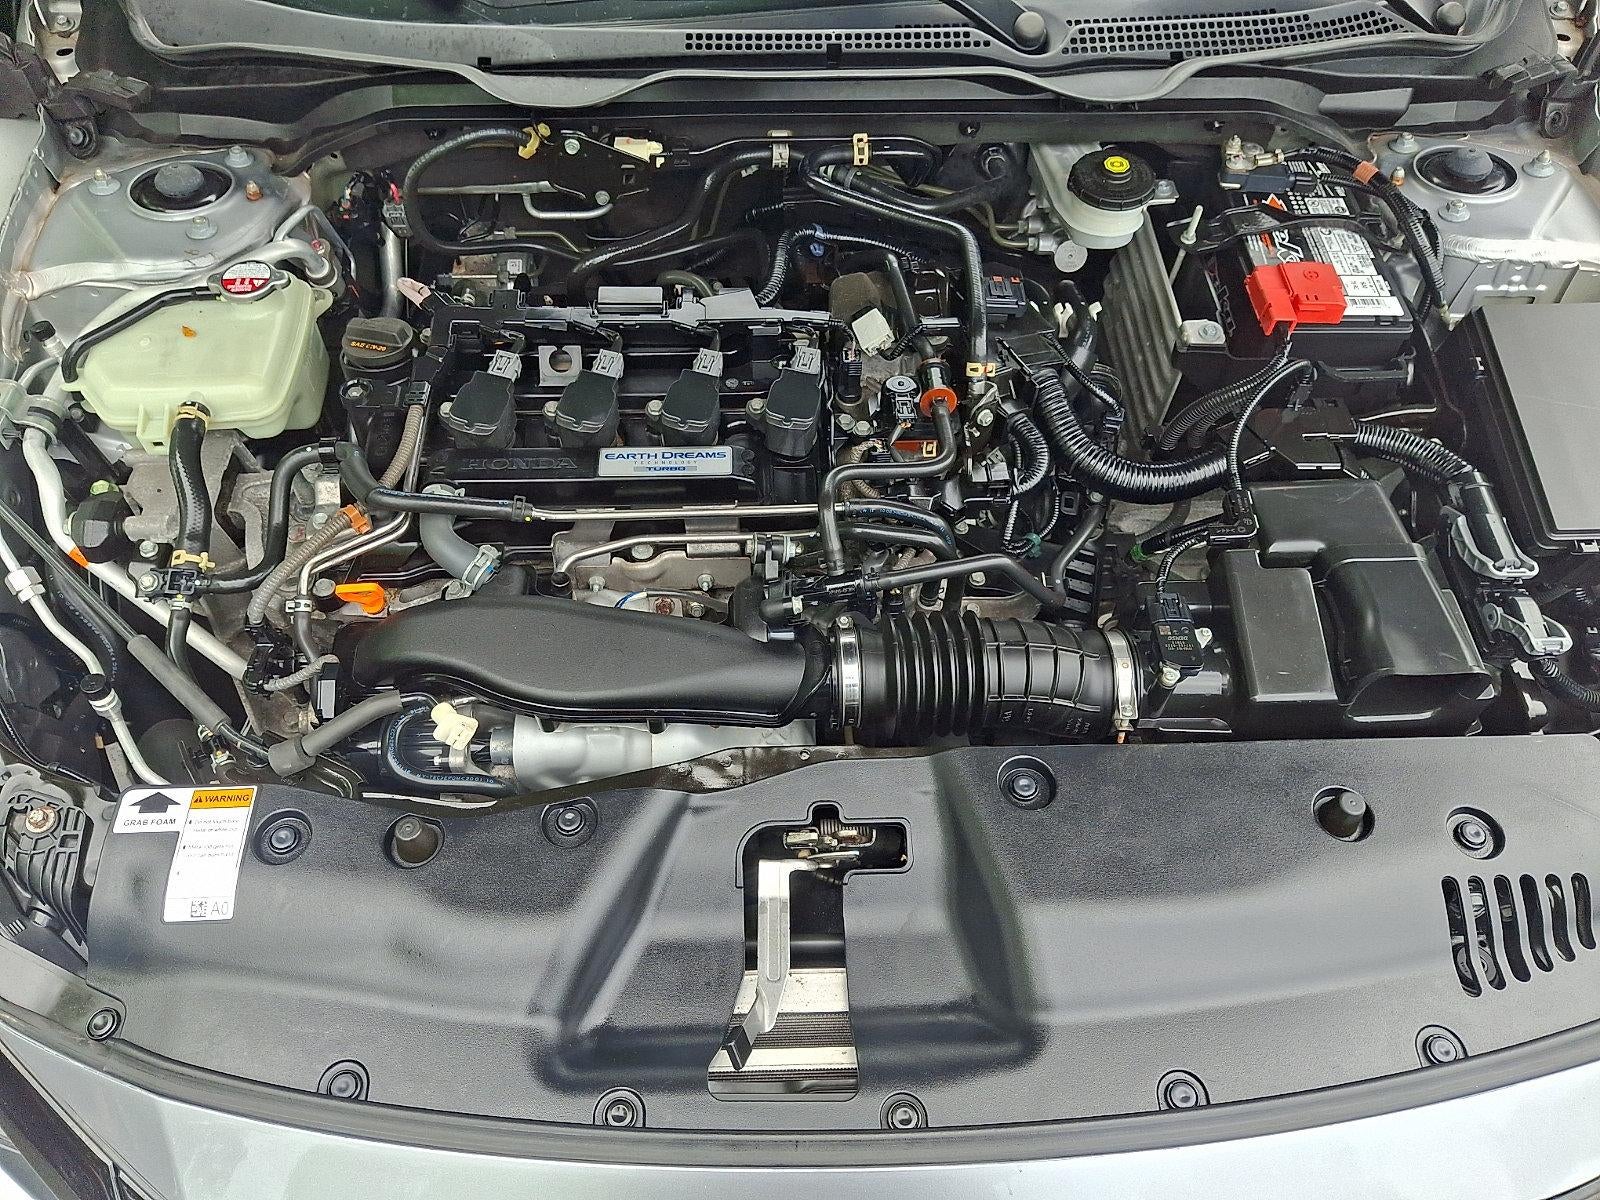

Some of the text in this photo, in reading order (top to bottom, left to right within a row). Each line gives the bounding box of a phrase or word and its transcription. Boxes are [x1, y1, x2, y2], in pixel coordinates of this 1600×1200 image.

[459, 457, 578, 470] HONDA
[205, 794, 250, 803] WARNING
[123, 819, 148, 827] GRAB
